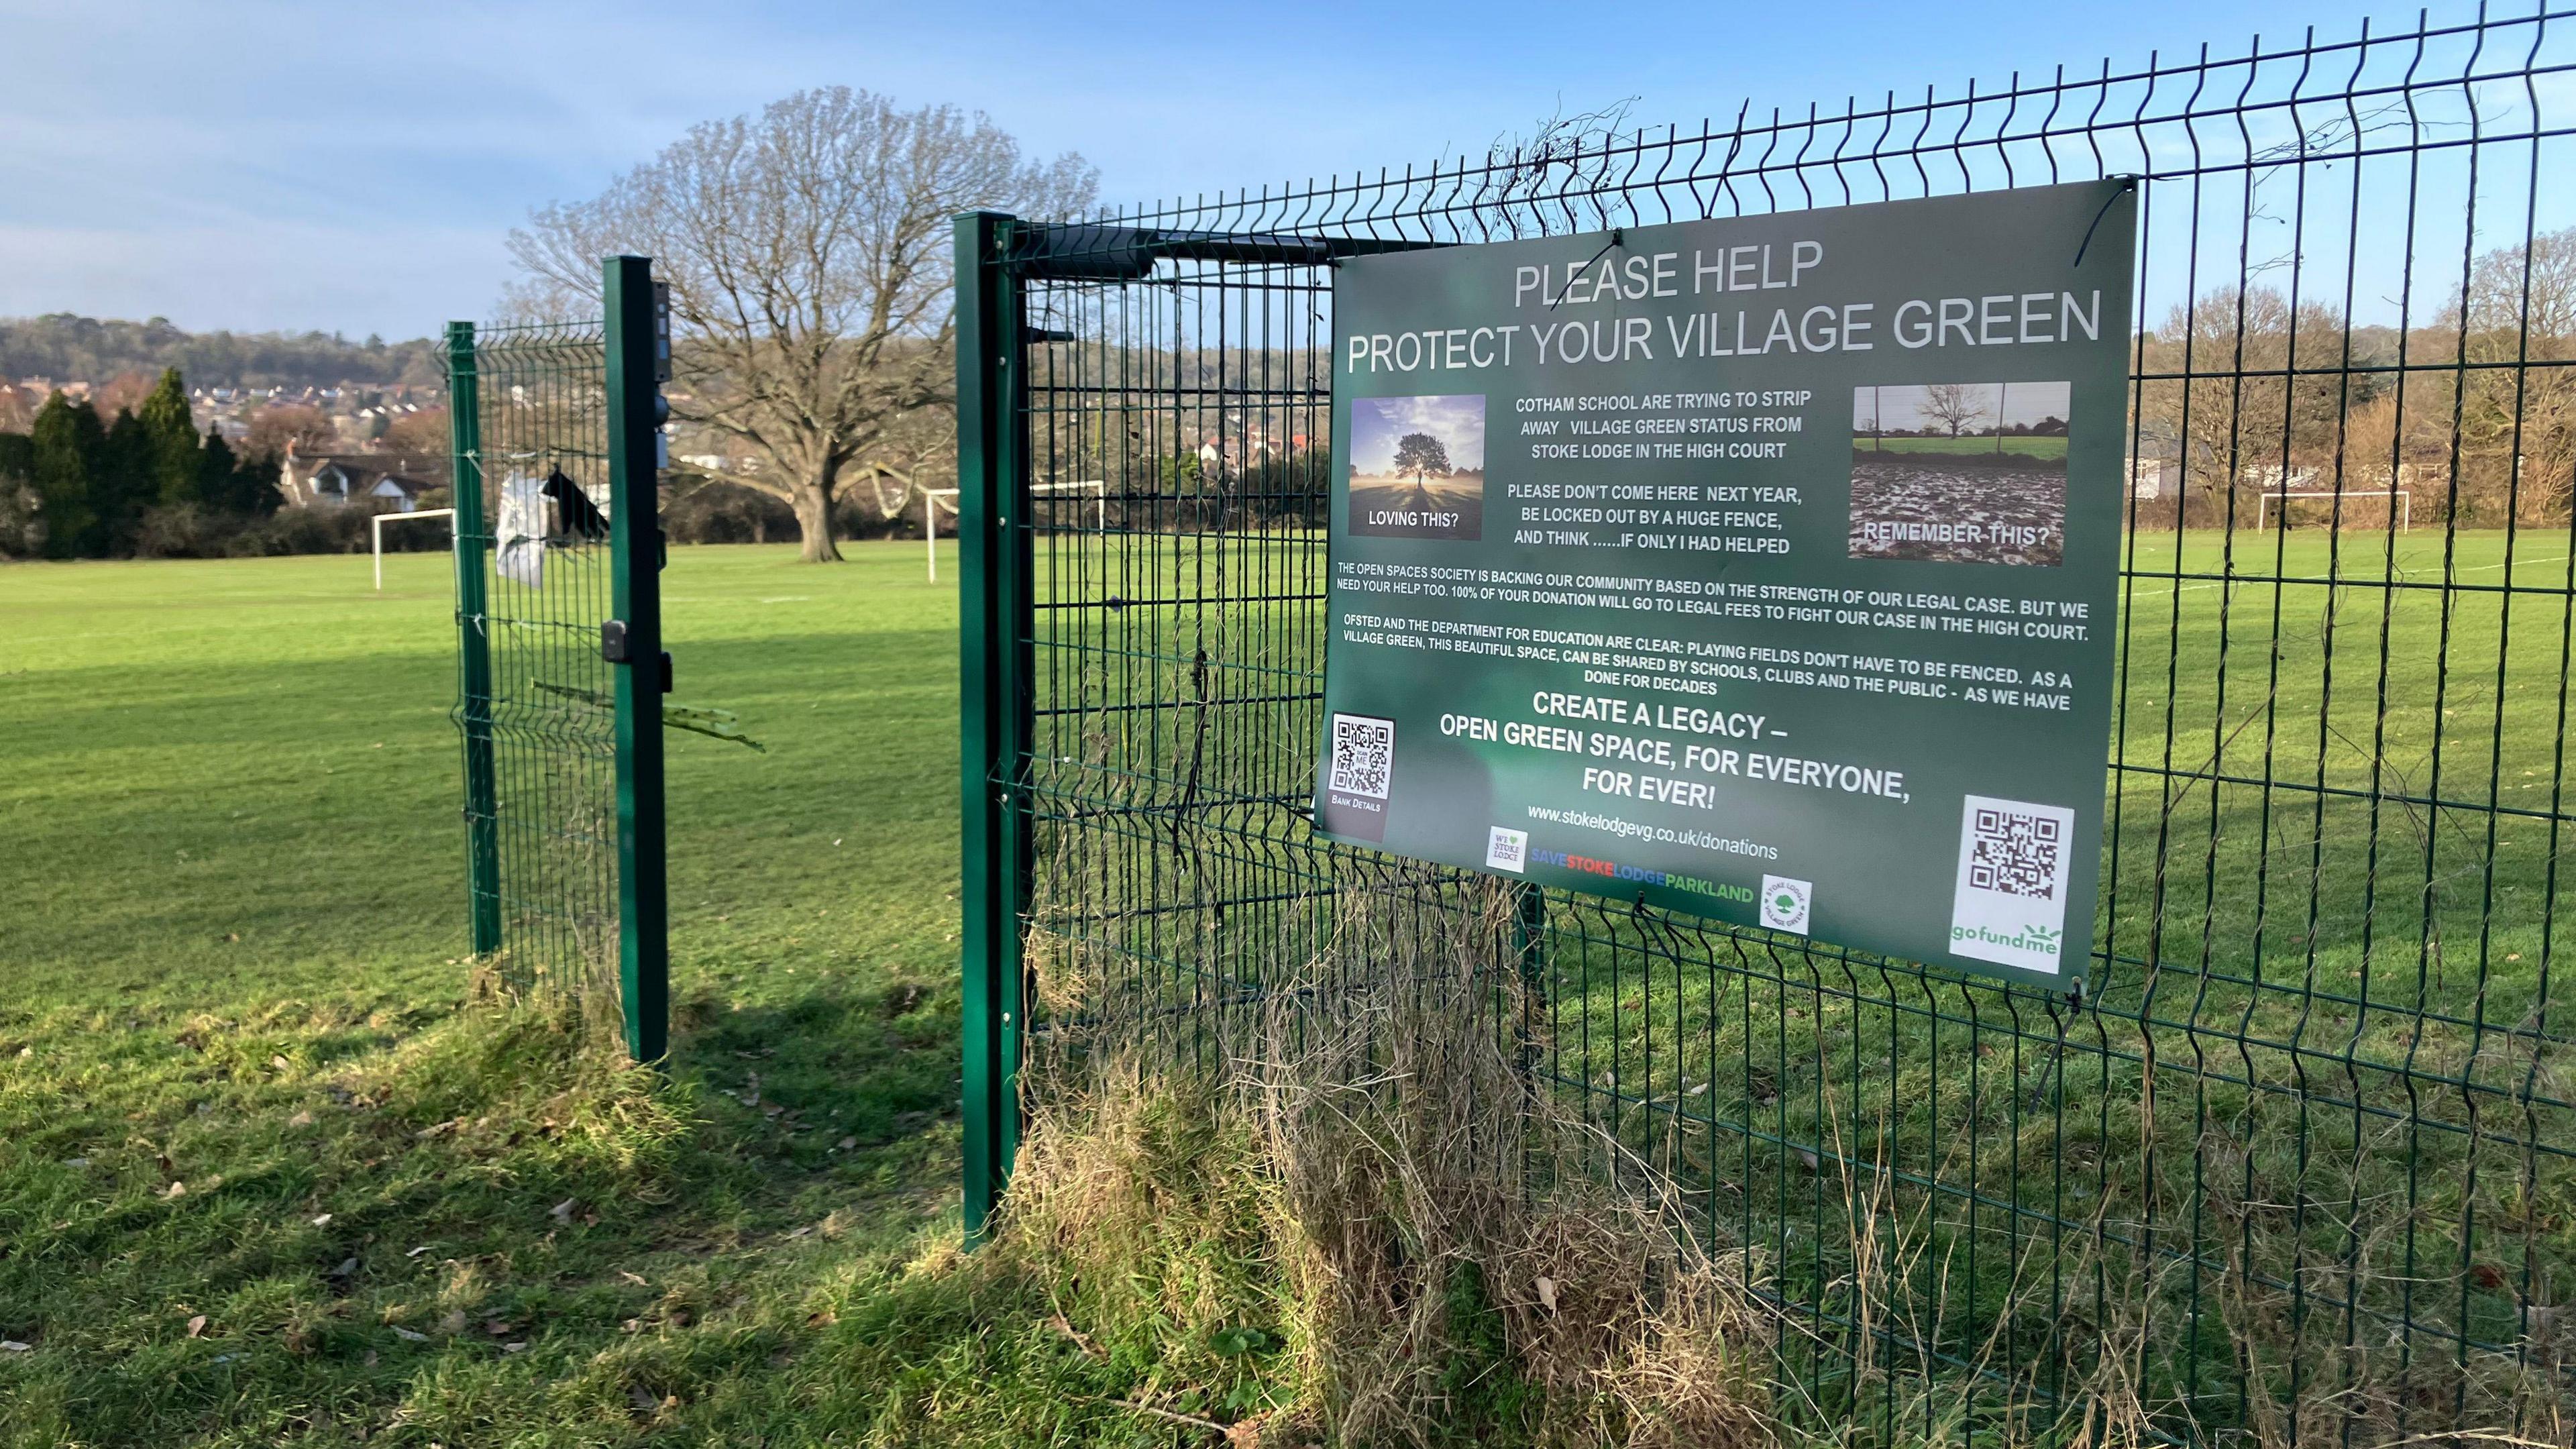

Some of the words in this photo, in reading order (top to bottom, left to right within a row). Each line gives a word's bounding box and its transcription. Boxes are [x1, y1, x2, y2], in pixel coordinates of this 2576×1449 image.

[1515, 253, 1677, 307] PLEASE
[1695, 241, 1823, 293] HELP
[1349, 326, 1519, 373] PROTECT
[1530, 318, 1653, 364] YOUR
[1667, 304, 1873, 358] VILLAGE
[1894, 290, 2100, 348] GREEN
[1516, 397, 1574, 412] COTHAM
[1578, 396, 1638, 411] SCHOOL
[1642, 394, 1671, 409] ARE
[1676, 392, 1730, 408] TRYING
[1735, 392, 1757, 407] TO
[1762, 391, 1811, 406] STRIP
[1521, 421, 1559, 435] AWAY
[1570, 420, 1631, 434] VILLAGE
[1635, 419, 1685, 433] GREEN
[1690, 418, 1748, 433] STATUS
[1754, 417, 1801, 432] FROM
[1532, 445, 1578, 458] STOKE
[1583, 444, 1631, 458] LODGE
[1636, 444, 1649, 458] IN
[1654, 444, 1682, 458] THE
[1687, 443, 1723, 458] HIGH
[1729, 443, 1786, 458] COURT
[1508, 484, 1560, 498] PLEASE
[1612, 485, 1653, 500] COME
[1658, 486, 1698, 500] HERE
[1707, 486, 1748, 501] NEXT
[1752, 487, 1801, 504] YEAR,
[1369, 511, 1417, 526] LOVING
[1421, 513, 1458, 527] THIS?
[1522, 507, 1539, 521] BE
[1544, 508, 1602, 522] LOCKED
[1606, 509, 1635, 523] OUT
[1640, 510, 1659, 524] BY
[1662, 511, 1673, 525] A
[1677, 511, 1719, 526] HUGE
[1725, 512, 1782, 530] FENCE,
[1514, 530, 1542, 543] AND
[1546, 531, 1589, 545] THINK
[1638, 534, 1676, 549] ONLY
[1680, 535, 1684, 549] I
[1688, 536, 1721, 551] HAD
[1726, 537, 1789, 553] HELPED
[1865, 523, 1984, 543] REMEMBER
[1988, 524, 2049, 545] THIS?
[1338, 562, 1354, 574] THE
[1357, 564, 1383, 575] OPEN
[1387, 565, 1428, 578] SPACES
[1431, 568, 1476, 581] SOCIETY
[1479, 570, 1488, 582] IS
[1492, 571, 1542, 585] BACKING
[1546, 574, 1572, 586] OUR
[1576, 576, 1653, 591] COMMUNITY
[1656, 580, 1701, 594] BASED
[1705, 582, 1724, 596] ON
[1729, 584, 1756, 597] THE
[1760, 586, 1838, 602] STRENGTH
[1843, 590, 1864, 604] OF
[1868, 592, 1902, 606] OUR
[1907, 594, 1960, 610] LEGAL
[1965, 597, 2015, 613] CASE.
[2021, 600, 2055, 616] BUT
[2060, 602, 2088, 618] WE
[1337, 578, 1360, 590] NEED
[1362, 580, 1390, 592] YOUR
[1393, 582, 1420, 594] HELP
[1424, 584, 1448, 596] TOO.
[1452, 586, 1477, 598] 100%
[1481, 588, 1495, 599] OF
[1498, 589, 1529, 602] YOUR
[1533, 591, 1595, 606] DONATION
[1599, 595, 1629, 608] WILL
[1633, 597, 1652, 610] GO
[1656, 598, 1673, 611] TO
[1677, 600, 1721, 614] LEGAL
[1725, 603, 1760, 617] FEES
[1765, 606, 1784, 619] TO
[1788, 607, 1832, 622] FIGHT
[1835, 610, 1869, 625] OUR
[1874, 612, 1916, 628] CASE
[1921, 616, 1936, 629] IN
[1941, 617, 1973, 632] THE
[1978, 619, 2019, 636] HIGH
[2024, 623, 2088, 641] COURT.
[1344, 614, 1381, 627] OFSTED
[1383, 617, 1405, 629] AND
[1408, 619, 1428, 631] THE
[1429, 621, 1503, 641] DEPARTMENT
[1506, 627, 1529, 641] FOR
[1533, 630, 1603, 647] EDUCATION
[1605, 636, 1632, 649] ARE
[1635, 638, 1683, 653] CLEAR:
[1688, 642, 1746, 659] PLAYING
[1750, 647, 1800, 663] FIELDS
[1854, 656, 1894, 672] HAVE
[1898, 659, 1920, 674] TO
[1925, 662, 1946, 677] BE
[1951, 664, 2022, 684] FENCED.
[2031, 672, 2055, 686] AS
[2059, 674, 2072, 688] A
[1344, 630, 1383, 644] VILLAGE
[1387, 634, 1425, 649] GREEN,
[1428, 638, 1452, 650] THIS
[1455, 640, 1514, 657] BEAUTIFUL
[1517, 646, 1559, 663] SPACE,
[1563, 650, 1589, 663] CAN
[1593, 653, 1609, 665] BE
[1613, 654, 1666, 670] SHARED
[1669, 659, 1688, 672] BY
[1690, 661, 1761, 685] SCHOOLS,
[1765, 669, 1814, 685] CLUBS
[1817, 674, 1849, 688] AND
[1854, 676, 1884, 692] THE
[1888, 680, 1946, 698] PUBLIC
[1964, 688, 1987, 702] AS
[1992, 690, 2019, 705] WE
[2024, 692, 2070, 710] HAVE
[1585, 670, 1620, 685] DONE
[1623, 674, 1650, 688] FOR
[1654, 677, 1717, 695] DECADES
[1534, 692, 1627, 723] CREATE
[1633, 703, 1651, 726] A
[1658, 705, 1765, 739] LEGACY
[1356, 756, 1367, 765] ME
[1441, 714, 1497, 741] OPEN
[1504, 722, 1582, 753] GREEN
[1590, 733, 1676, 770] SPACE,
[1685, 745, 1739, 775] FOR
[1747, 753, 1909, 804] EVERYONE,
[1583, 767, 1632, 796] FOR
[1639, 776, 1715, 809] EVER!
[1528, 804, 1777, 859] www.stokelodgevg.co.uk/donations
[1952, 926, 2057, 955] gofundme
